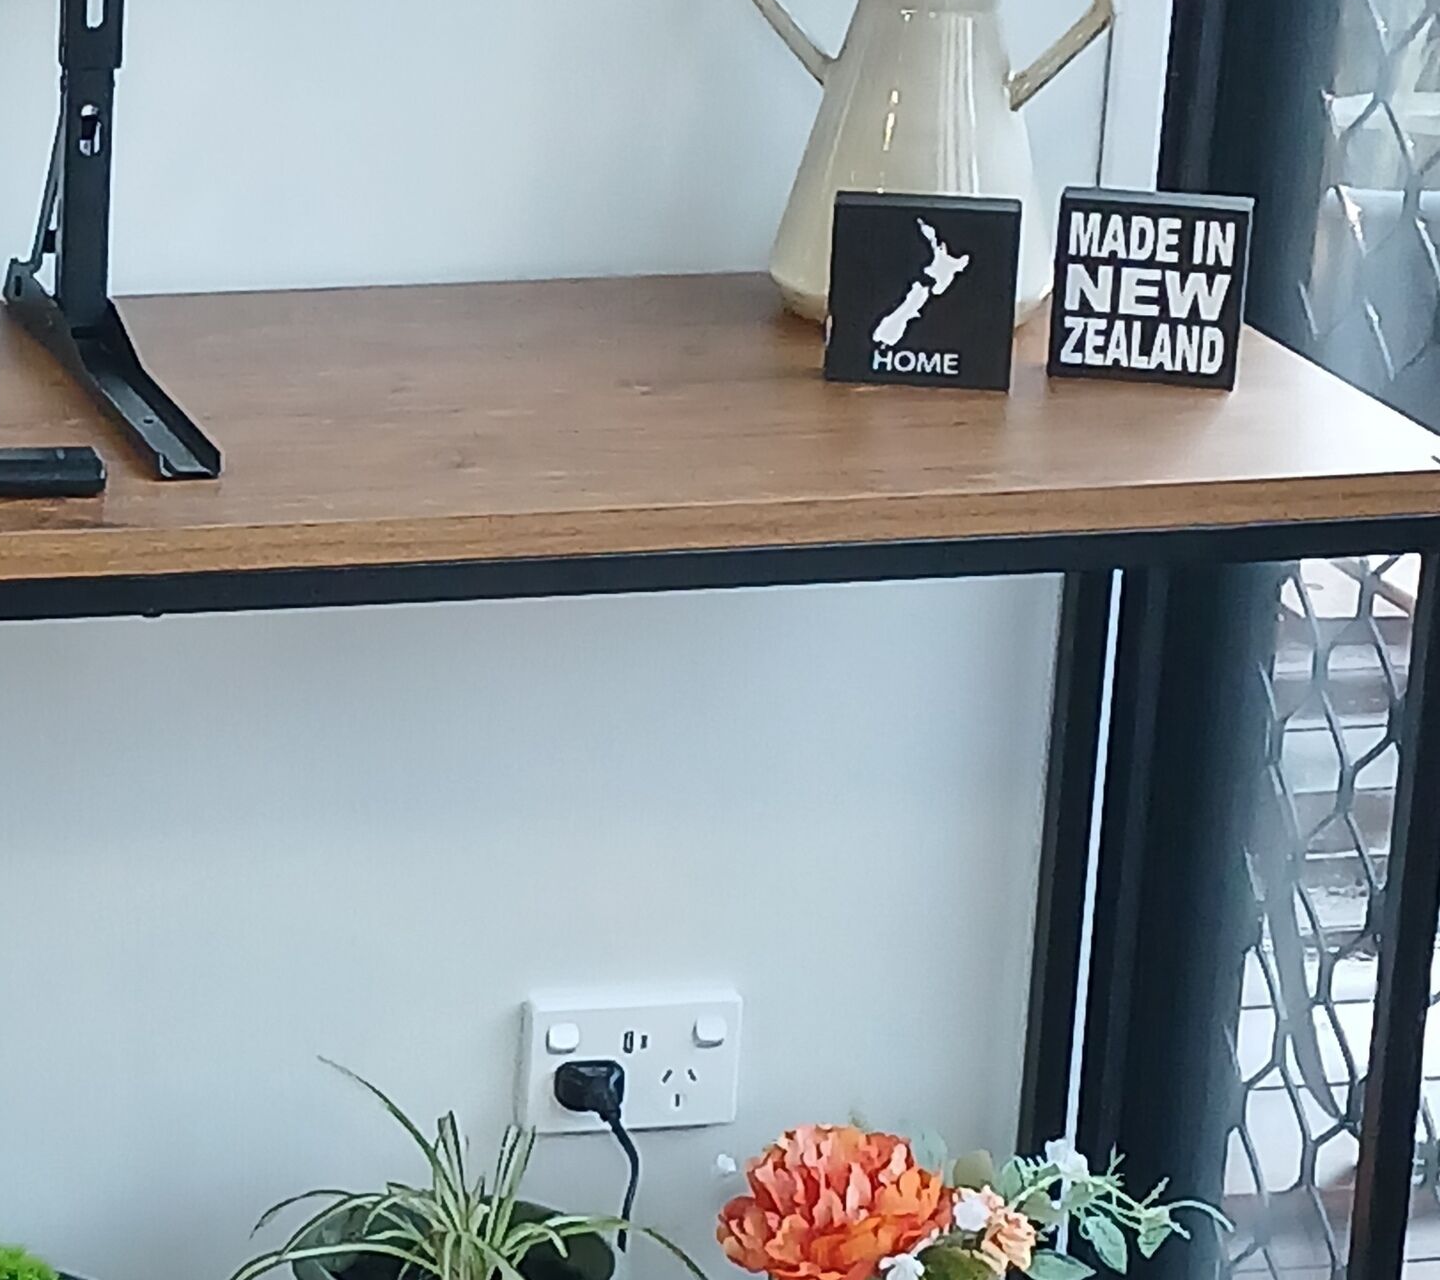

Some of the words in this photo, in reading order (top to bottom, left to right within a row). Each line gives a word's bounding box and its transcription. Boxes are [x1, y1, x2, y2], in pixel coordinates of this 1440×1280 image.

[1068, 211, 1181, 263] MADE
[1192, 220, 1235, 267] IN
[1064, 263, 1231, 321] NEW
[872, 349, 959, 376] HOME
[1059, 316, 1224, 376] ZEALAND
